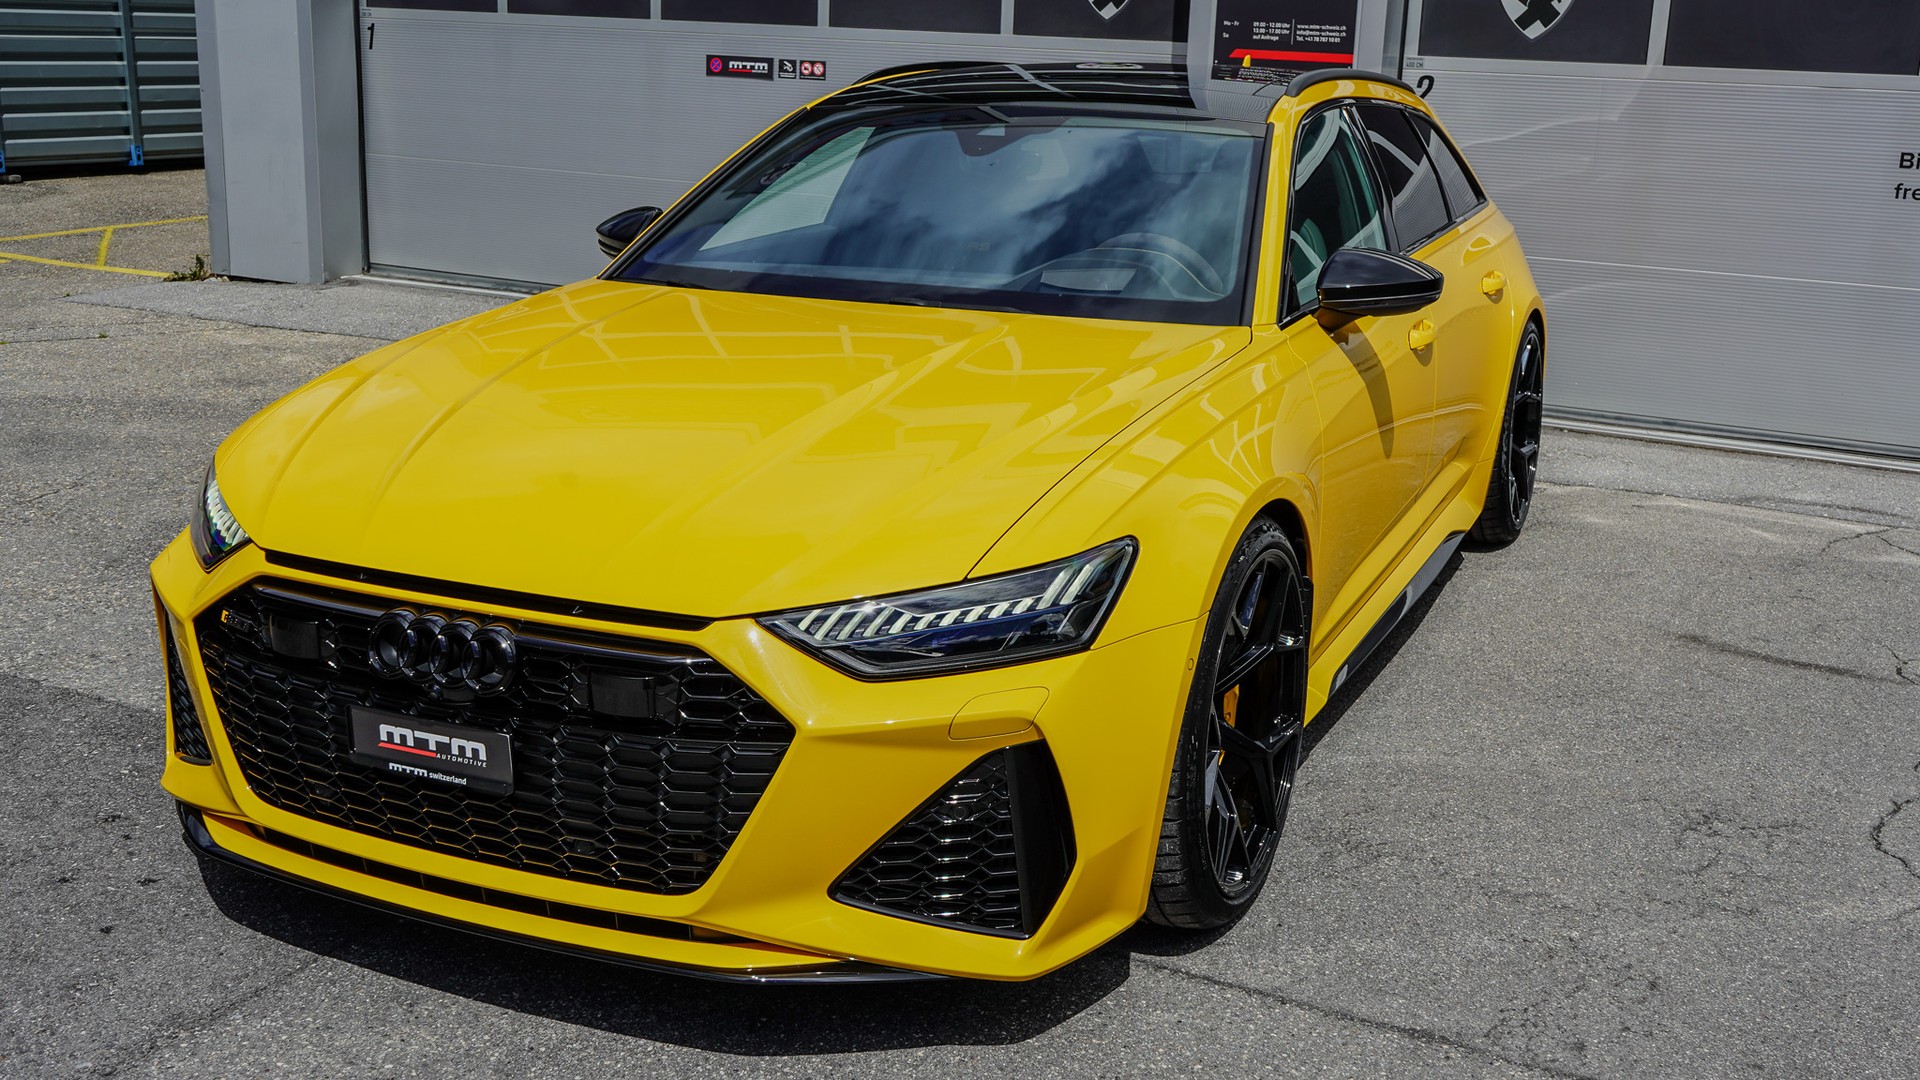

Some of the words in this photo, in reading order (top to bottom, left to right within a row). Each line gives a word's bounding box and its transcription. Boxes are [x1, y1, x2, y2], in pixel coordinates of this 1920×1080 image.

[367, 22, 375, 50] 1
[1416, 75, 1435, 99] 2
[436, 753, 488, 768] AUTOMOTIVE
[428, 771, 467, 786] switzerland
